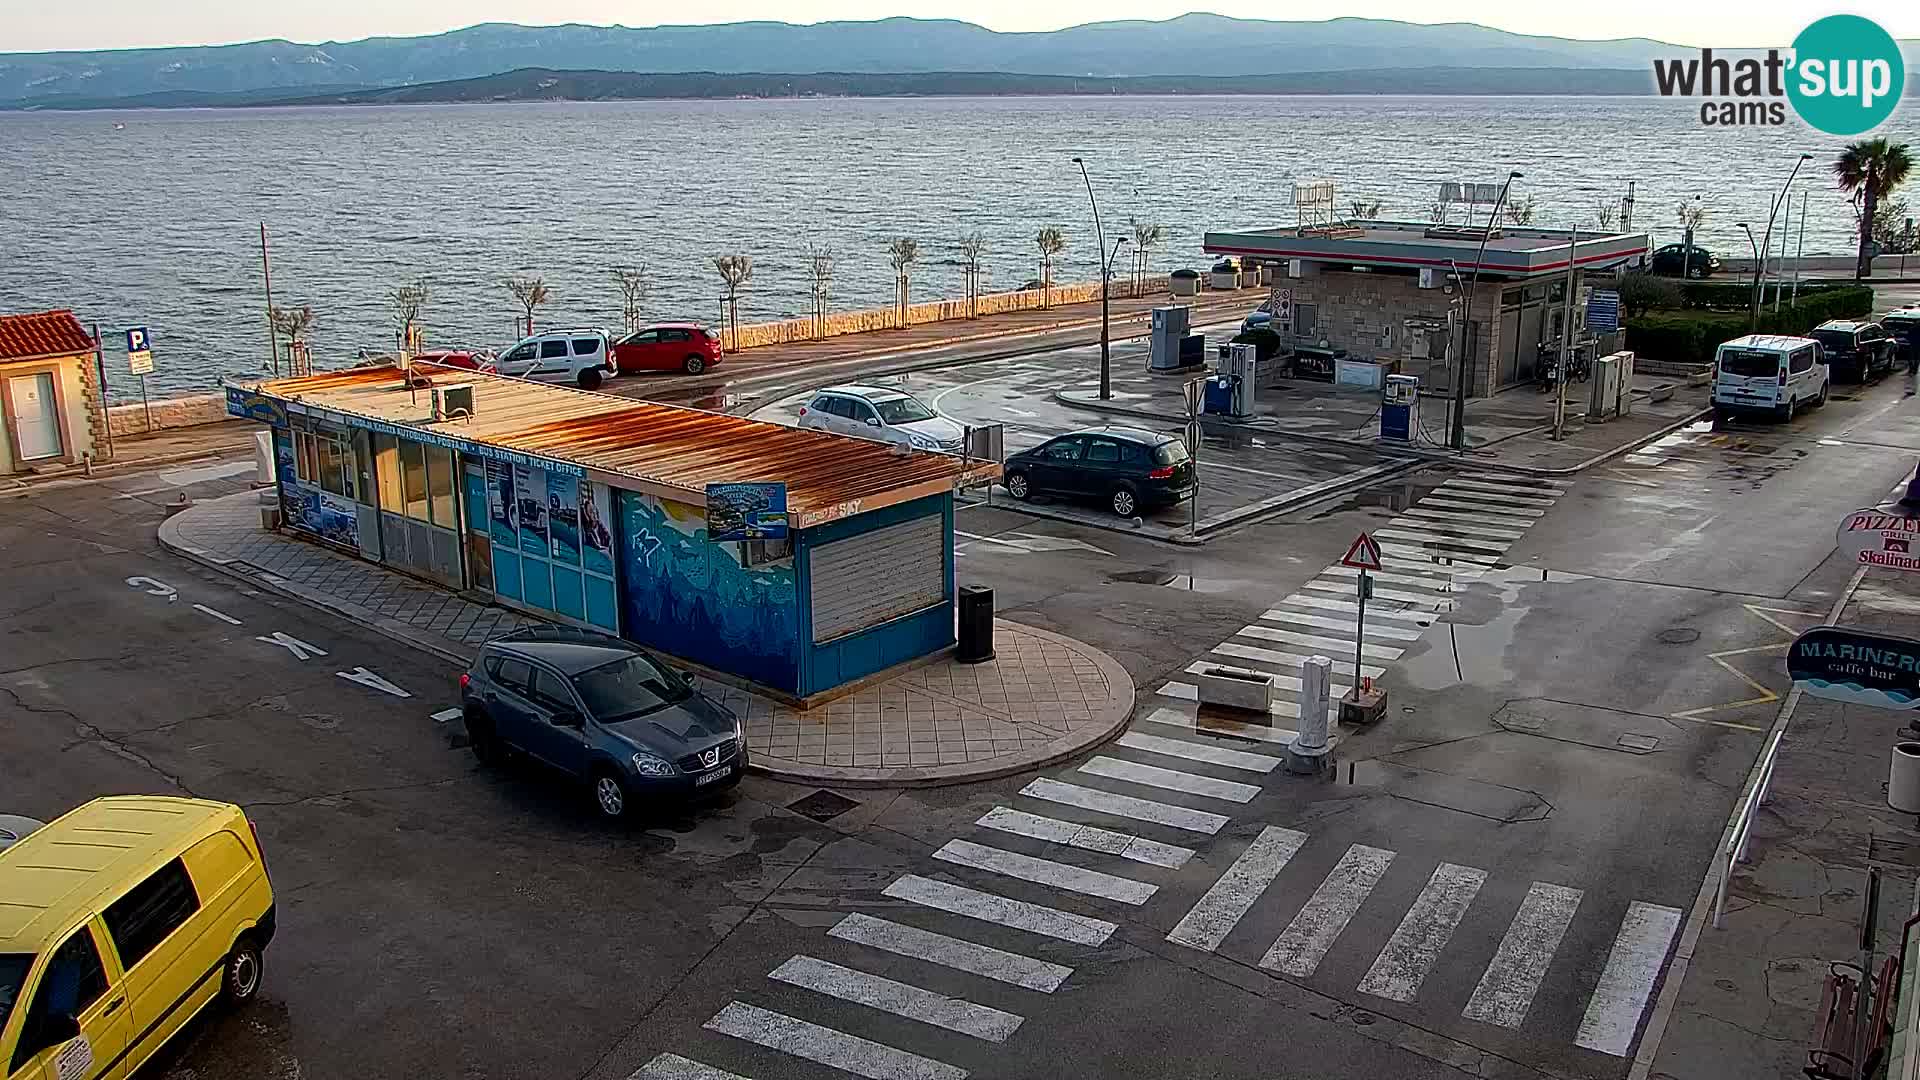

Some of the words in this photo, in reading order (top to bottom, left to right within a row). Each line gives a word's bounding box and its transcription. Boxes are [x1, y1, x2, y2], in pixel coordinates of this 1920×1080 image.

[131, 330, 144, 350] P
[479, 445, 494, 458] BUS
[495, 449, 527, 464] STATION
[528, 456, 555, 471] TICKET
[555, 461, 583, 477] OFFICE
[1847, 515, 1920, 533] PIZZE
[1880, 530, 1917, 541] GRILL
[1828, 662, 1865, 675] caffe
[1870, 665, 1897, 681] bar
